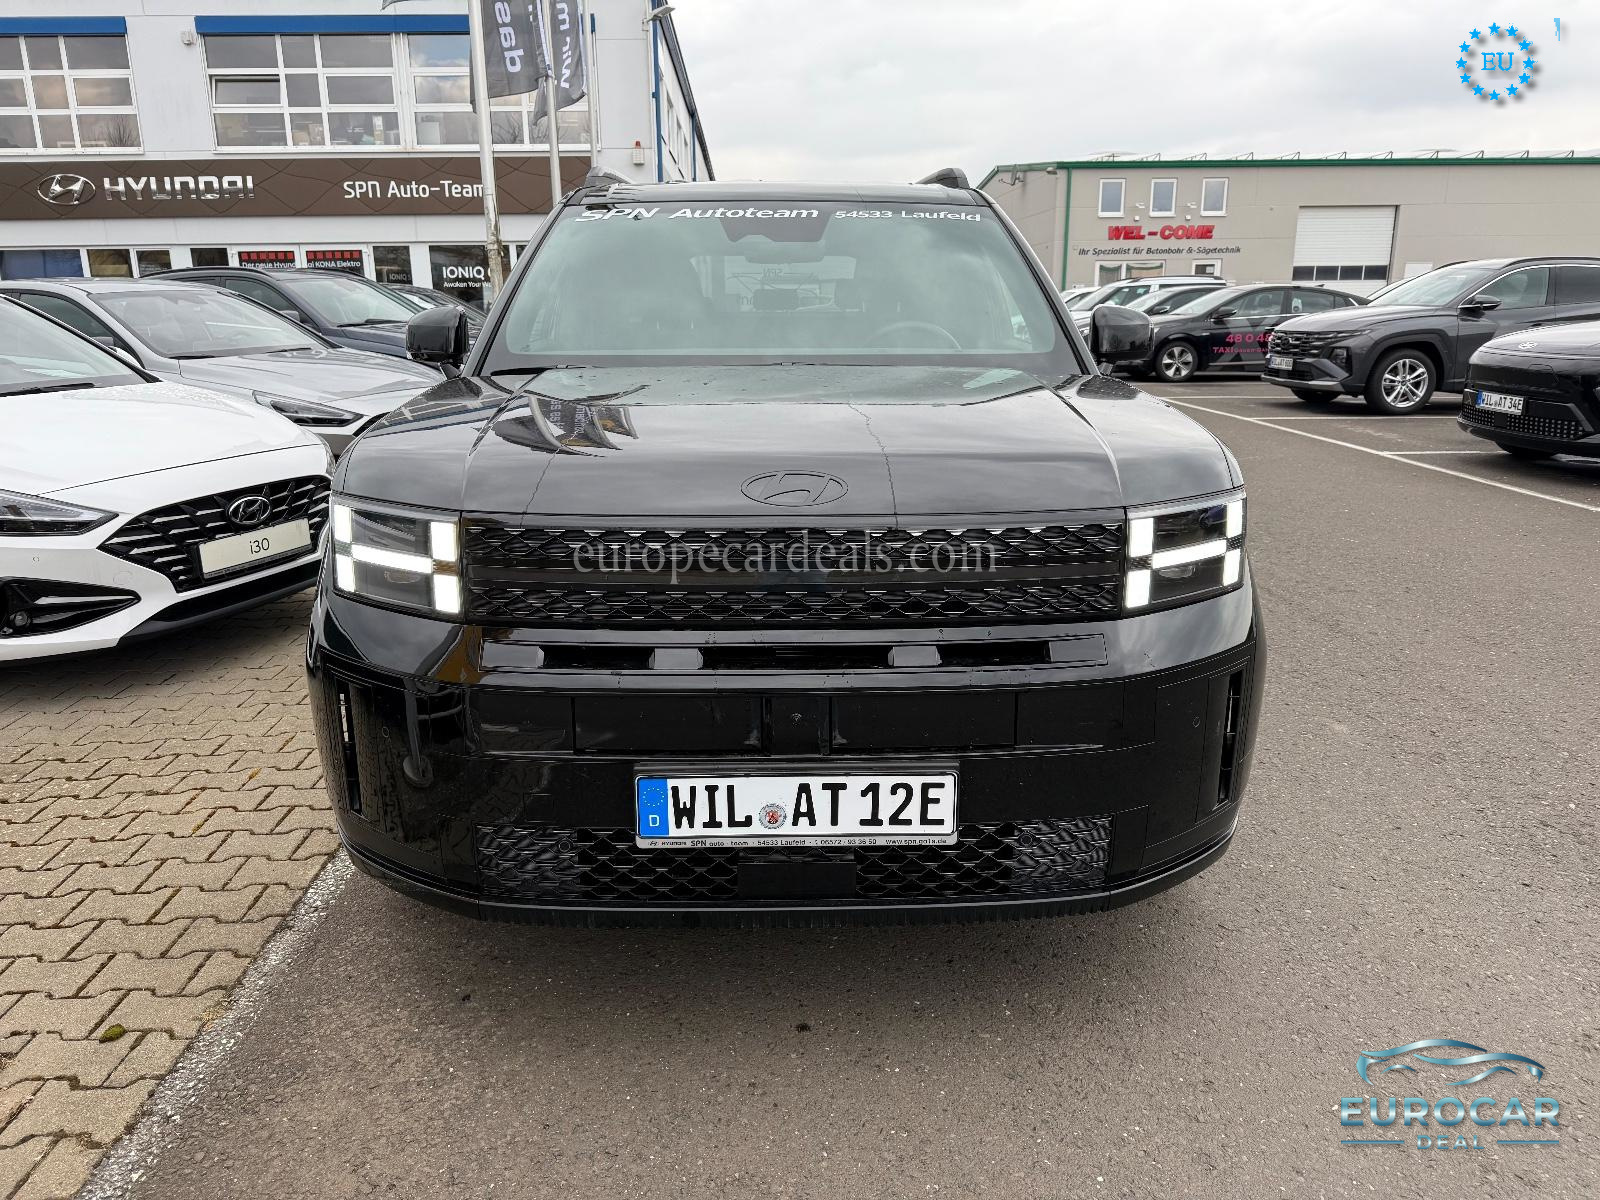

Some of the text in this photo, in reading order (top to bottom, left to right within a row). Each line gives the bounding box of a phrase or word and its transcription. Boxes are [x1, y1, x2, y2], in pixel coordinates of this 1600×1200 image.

[103, 175, 255, 201] HYUNDAI
[343, 181, 381, 198] SPN
[575, 207, 981, 222] SPN Autoteam 54533 Laufeld
[1078, 247, 1090, 256] Ihr
[1092, 247, 1130, 257] Spezialist
[1132, 246, 1144, 256] für
[1146, 246, 1184, 255] Betonbohr
[315, 260, 336, 268] KONA
[337, 260, 360, 268] Elektro
[442, 266, 485, 281] IONIQ
[1498, 396, 1508, 409] AT
[249, 537, 270, 555] i30
[671, 782, 946, 829] WIL AT 12E
[649, 815, 660, 827] D
[780, 838, 806, 846] Laufeld
